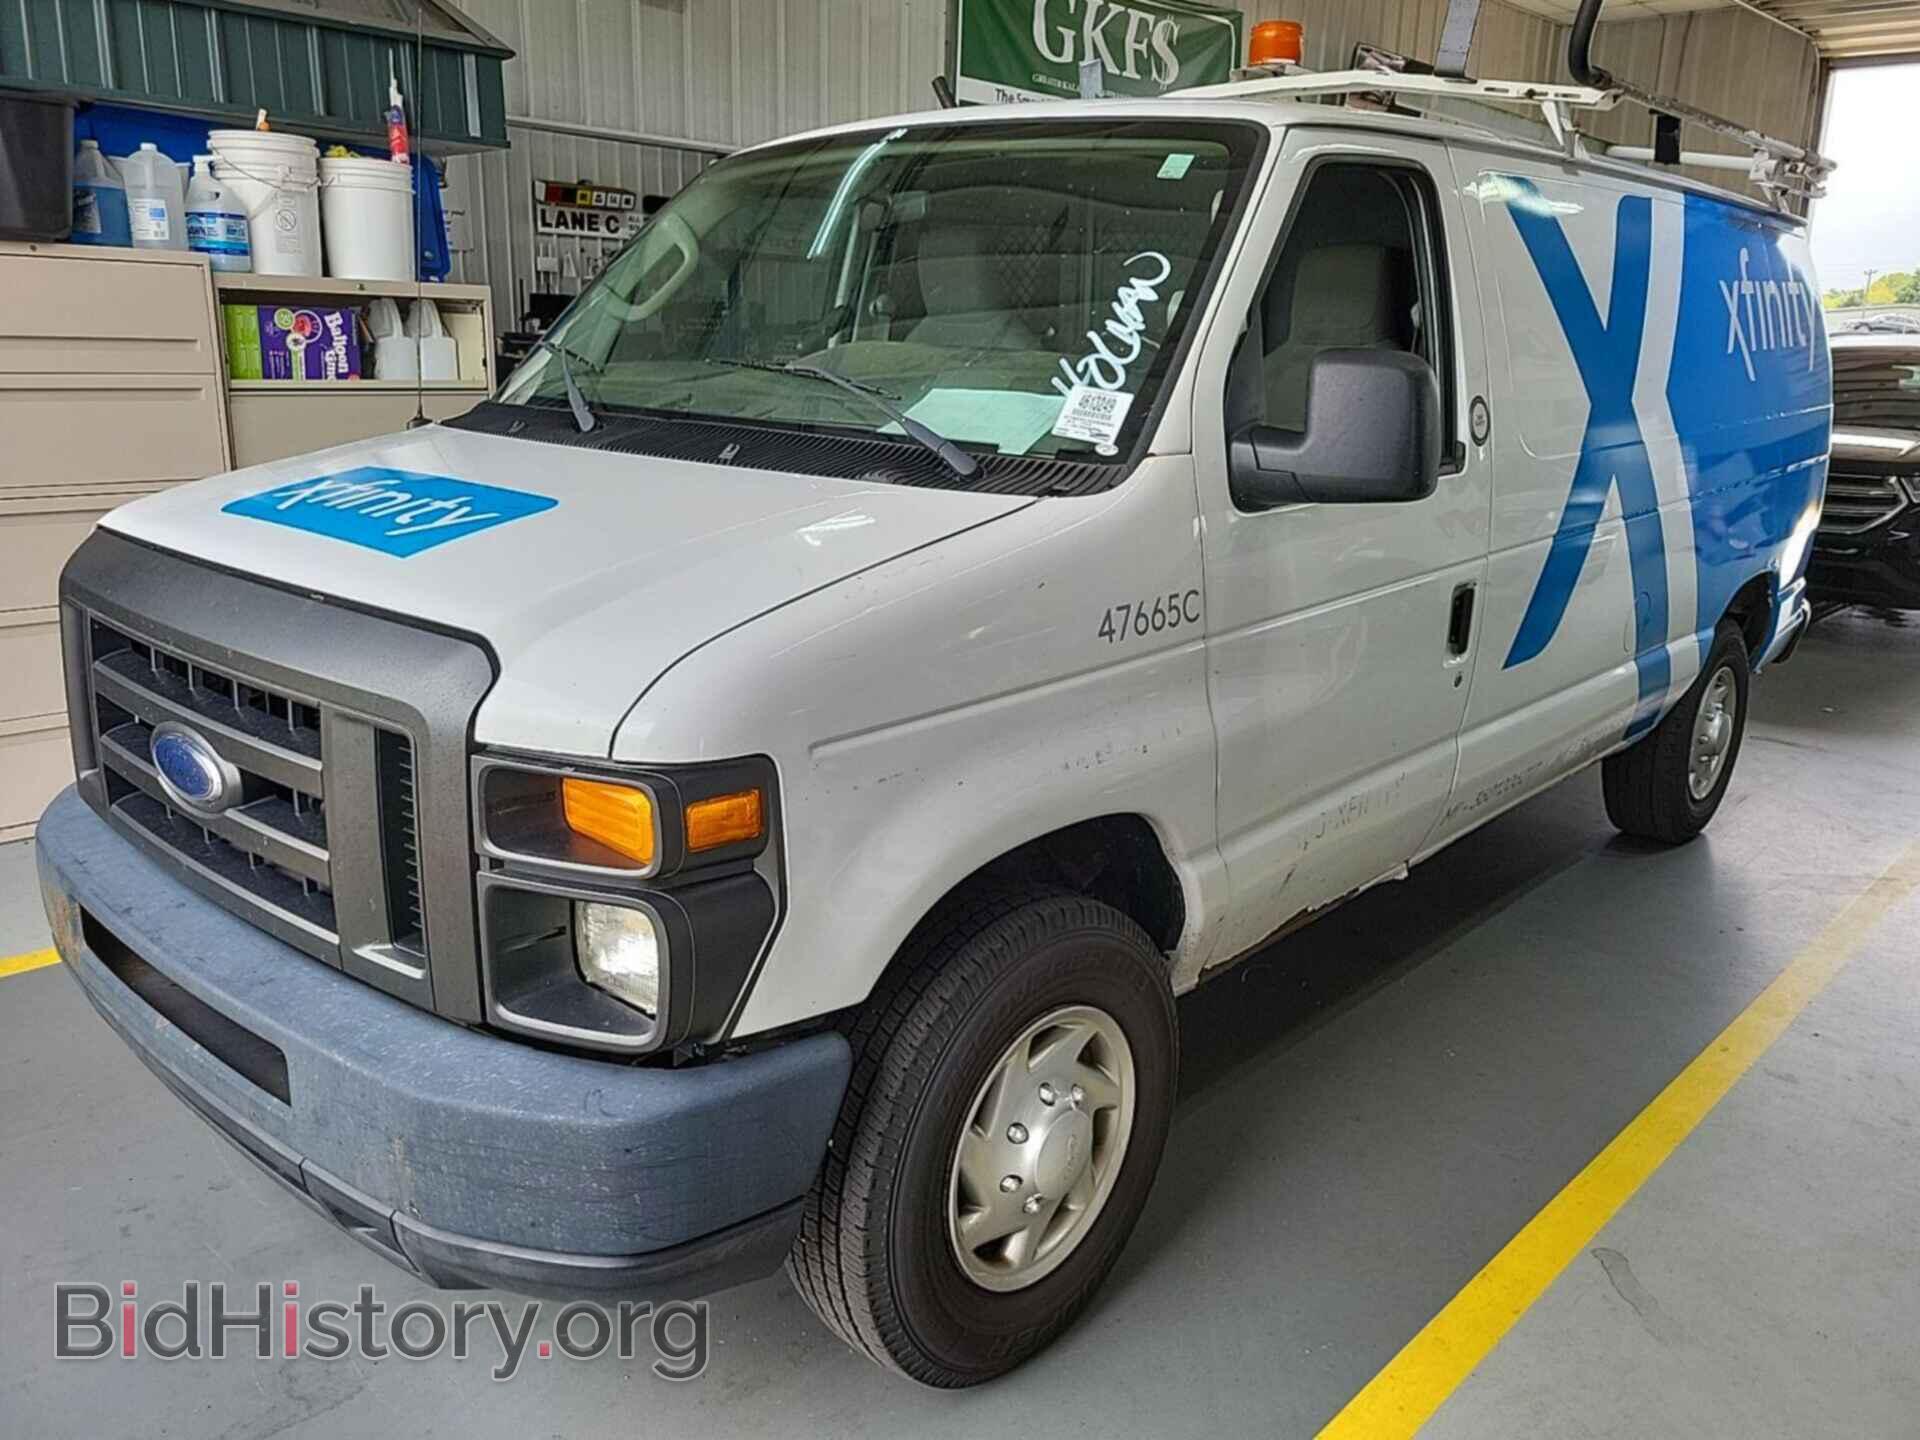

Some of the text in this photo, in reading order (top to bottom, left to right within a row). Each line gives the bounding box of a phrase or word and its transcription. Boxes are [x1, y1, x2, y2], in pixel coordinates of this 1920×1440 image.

[995, 88, 1014, 104] The
[540, 209, 620, 234] LANE C
[1718, 247, 1816, 382] xfinity
[324, 311, 349, 374] Balloon
[272, 480, 501, 536] xfinity
[1098, 590, 1200, 643] 47665C
